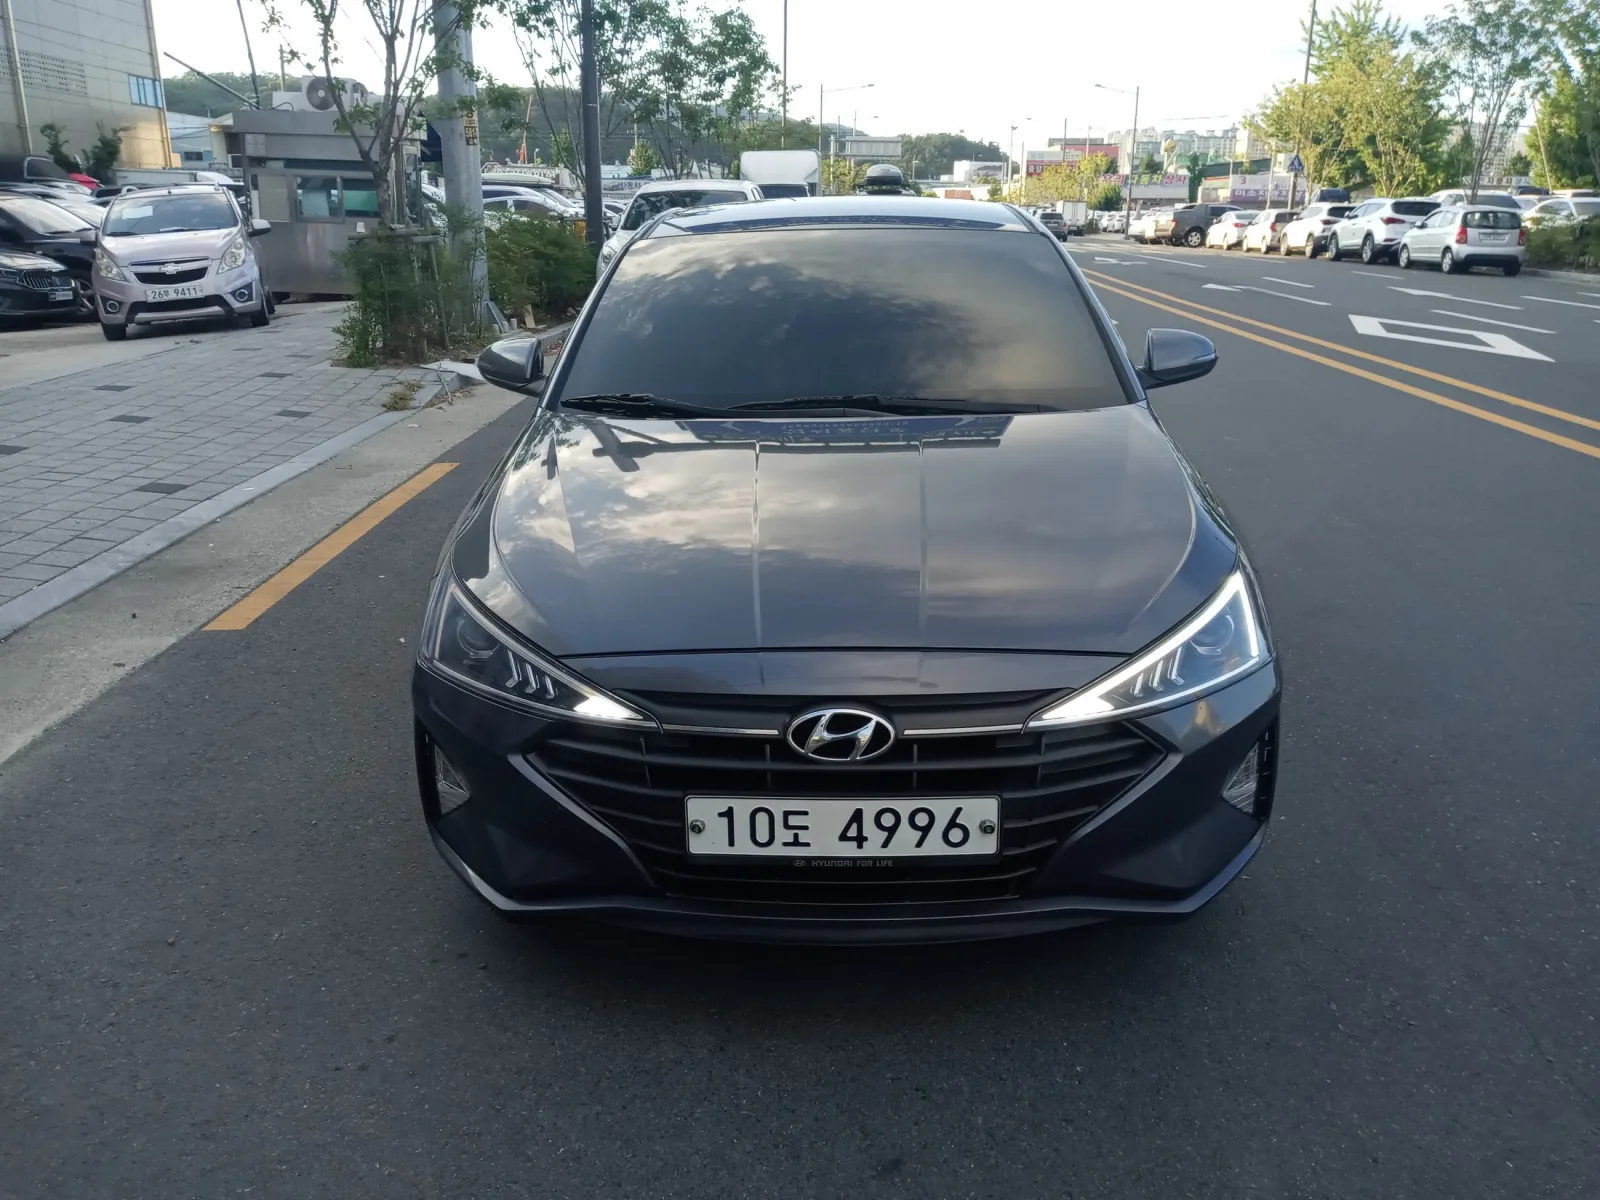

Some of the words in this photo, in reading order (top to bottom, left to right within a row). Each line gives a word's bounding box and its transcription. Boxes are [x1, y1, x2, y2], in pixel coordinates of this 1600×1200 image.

[173, 287, 198, 297] 9411
[716, 805, 812, 848] 10도
[837, 806, 971, 849] 4996
[811, 859, 854, 868] HYUNDAI
[856, 859, 873, 868] FOR
[876, 859, 894, 868] LIFE
